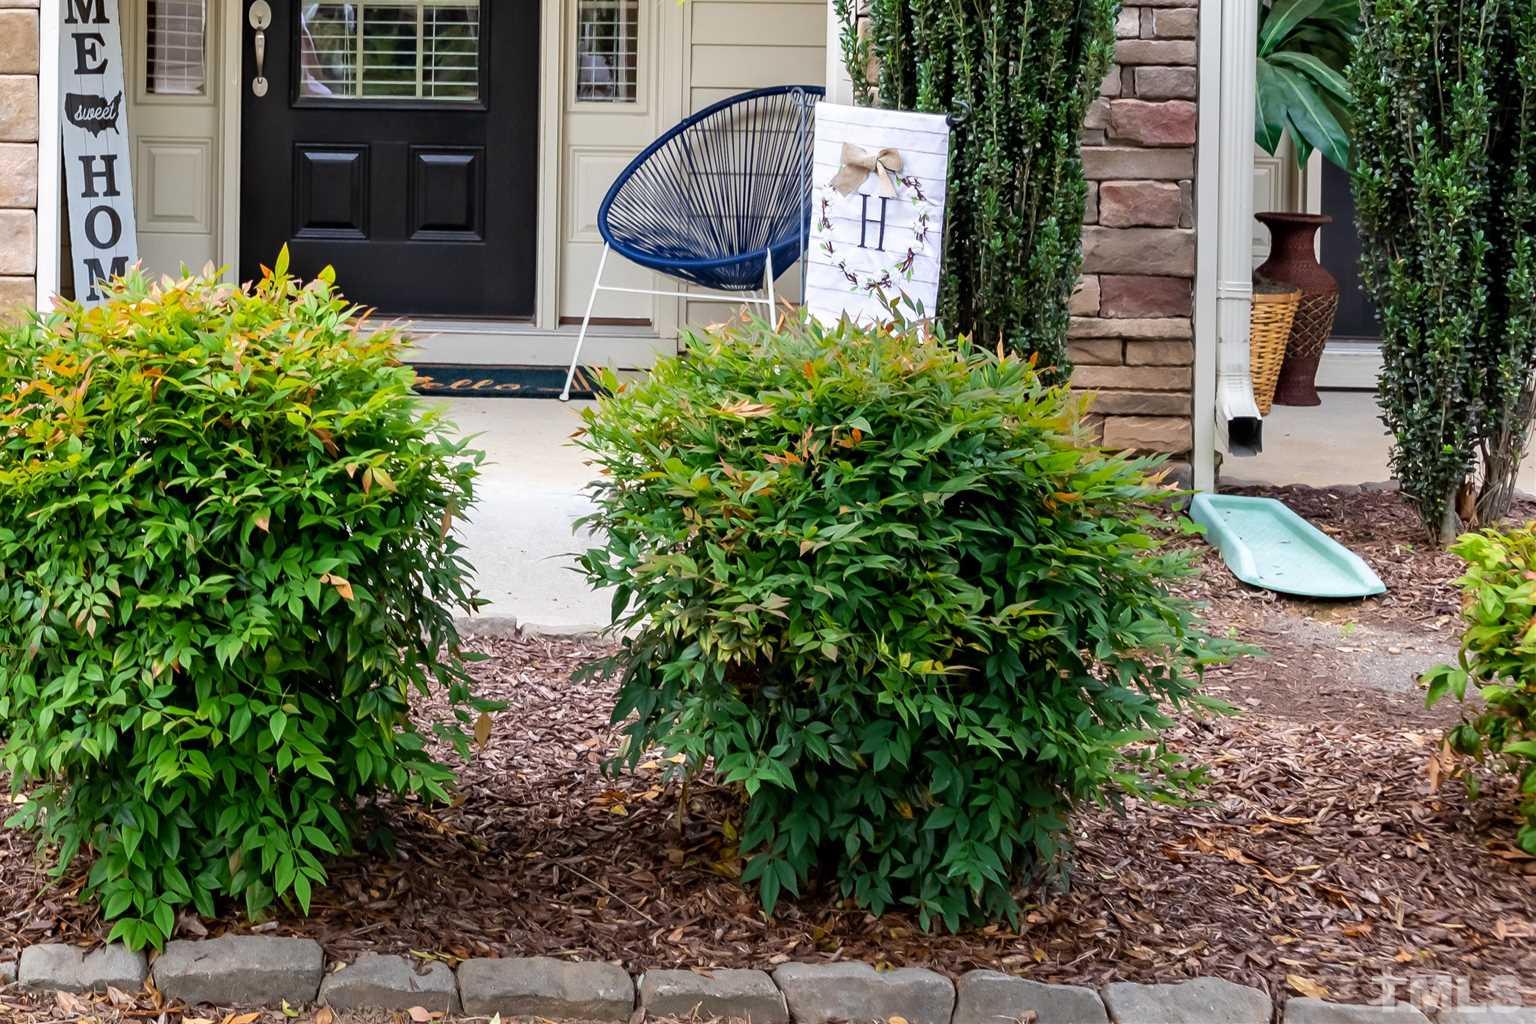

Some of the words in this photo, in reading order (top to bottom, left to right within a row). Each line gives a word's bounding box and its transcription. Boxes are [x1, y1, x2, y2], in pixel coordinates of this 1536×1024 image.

[74, 104, 116, 121] sweet
[78, 154, 129, 302] HOM
[857, 193, 886, 252] H
